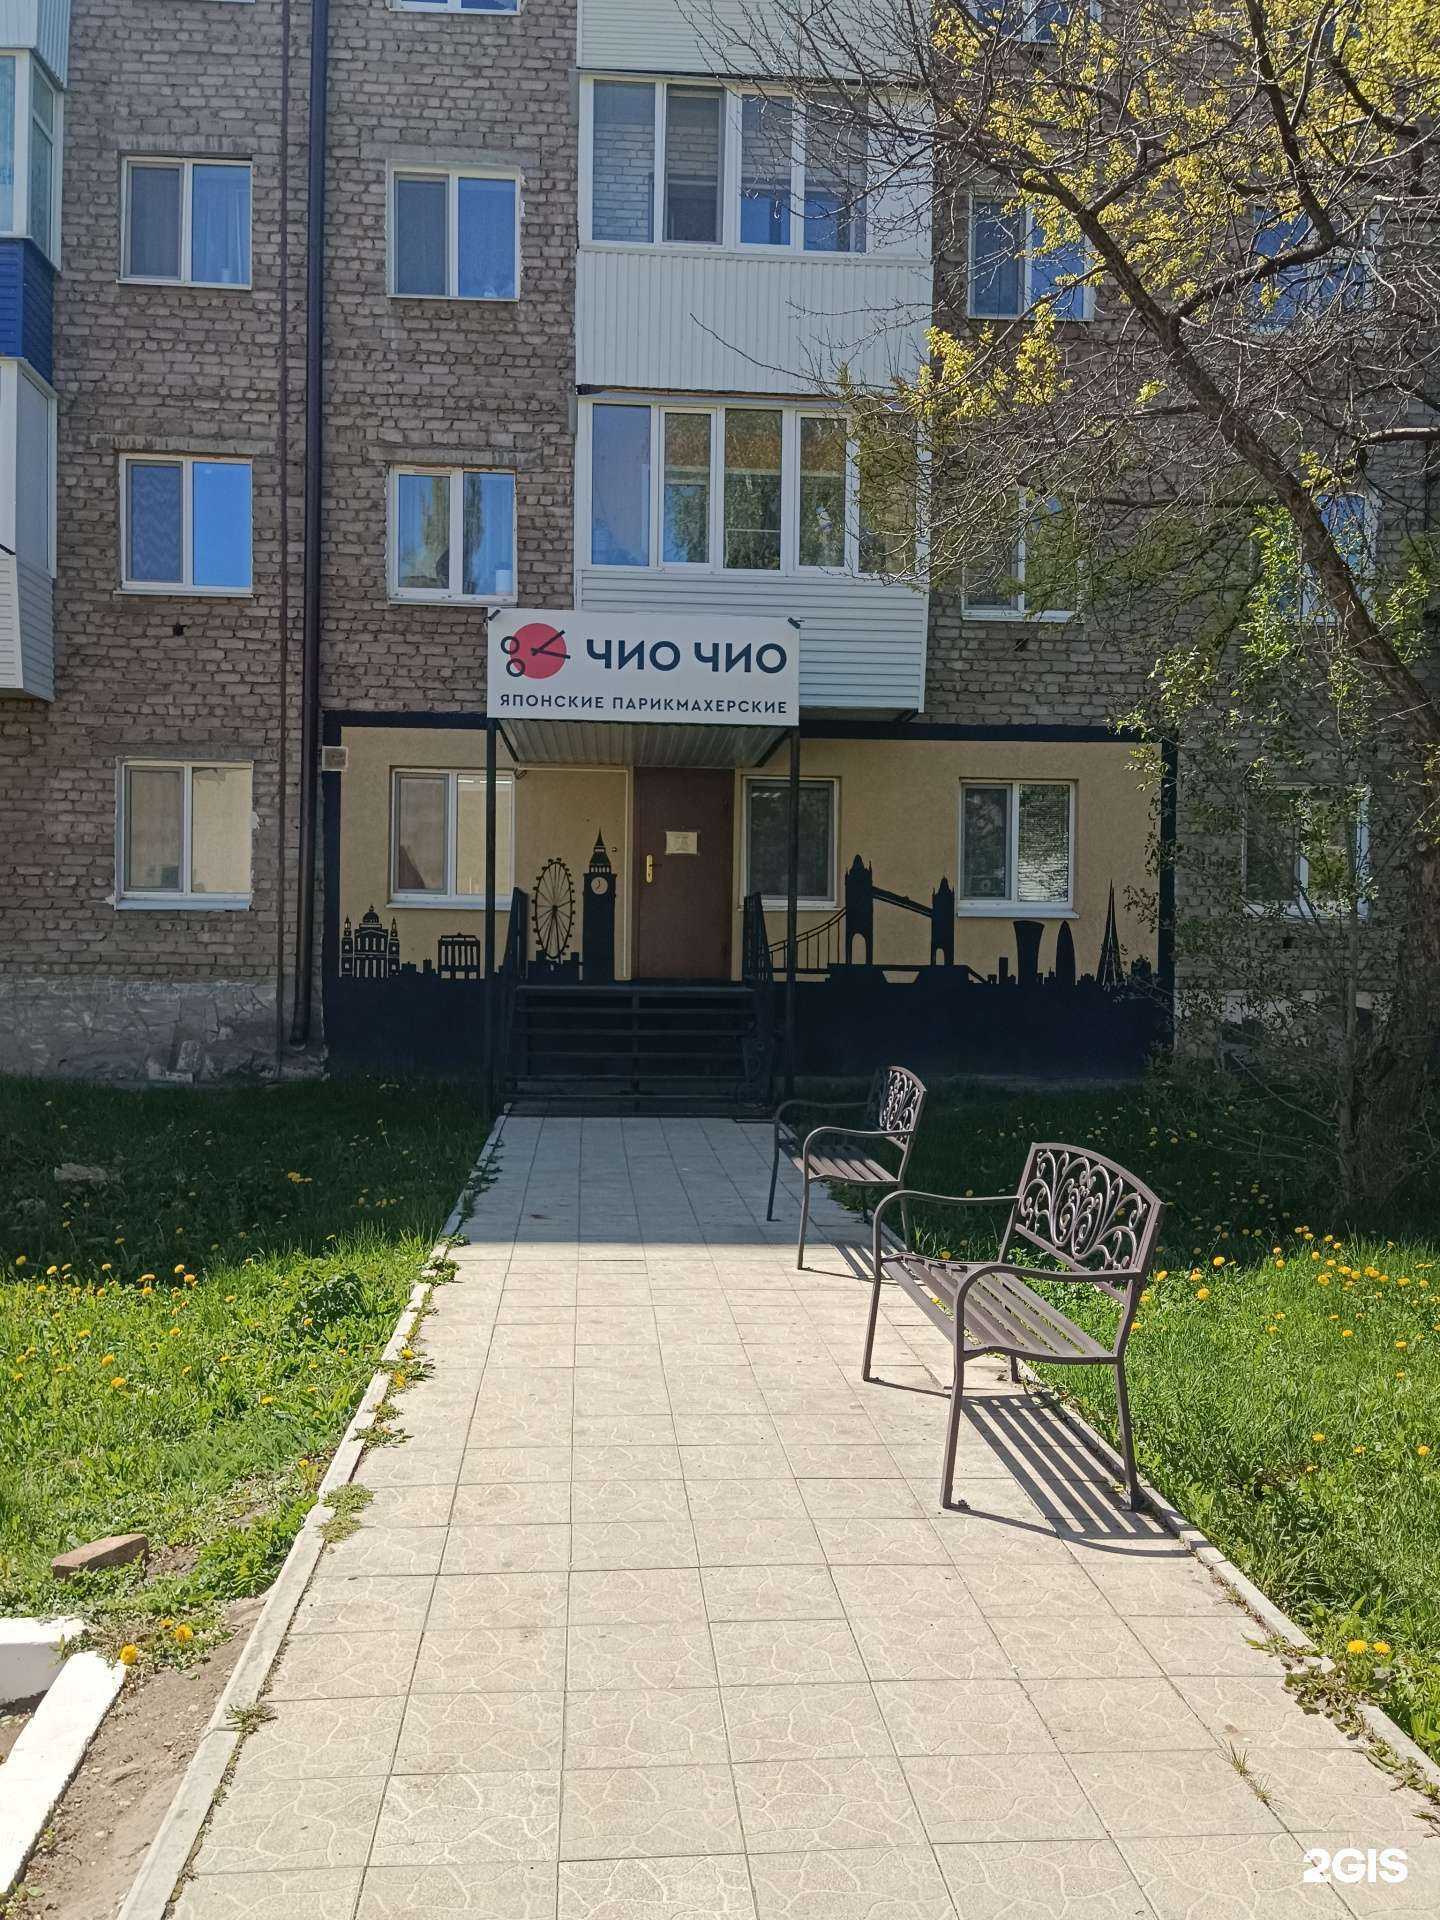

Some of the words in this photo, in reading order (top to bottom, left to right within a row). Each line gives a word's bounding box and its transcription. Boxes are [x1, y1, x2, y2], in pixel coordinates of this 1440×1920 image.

[586, 639, 681, 672] ЧИО
[694, 641, 787, 674] ЧИО
[500, 694, 604, 709] ЯПОНСКИЕ
[613, 697, 787, 714] ПАРИКМАХЕРСКИЕ
